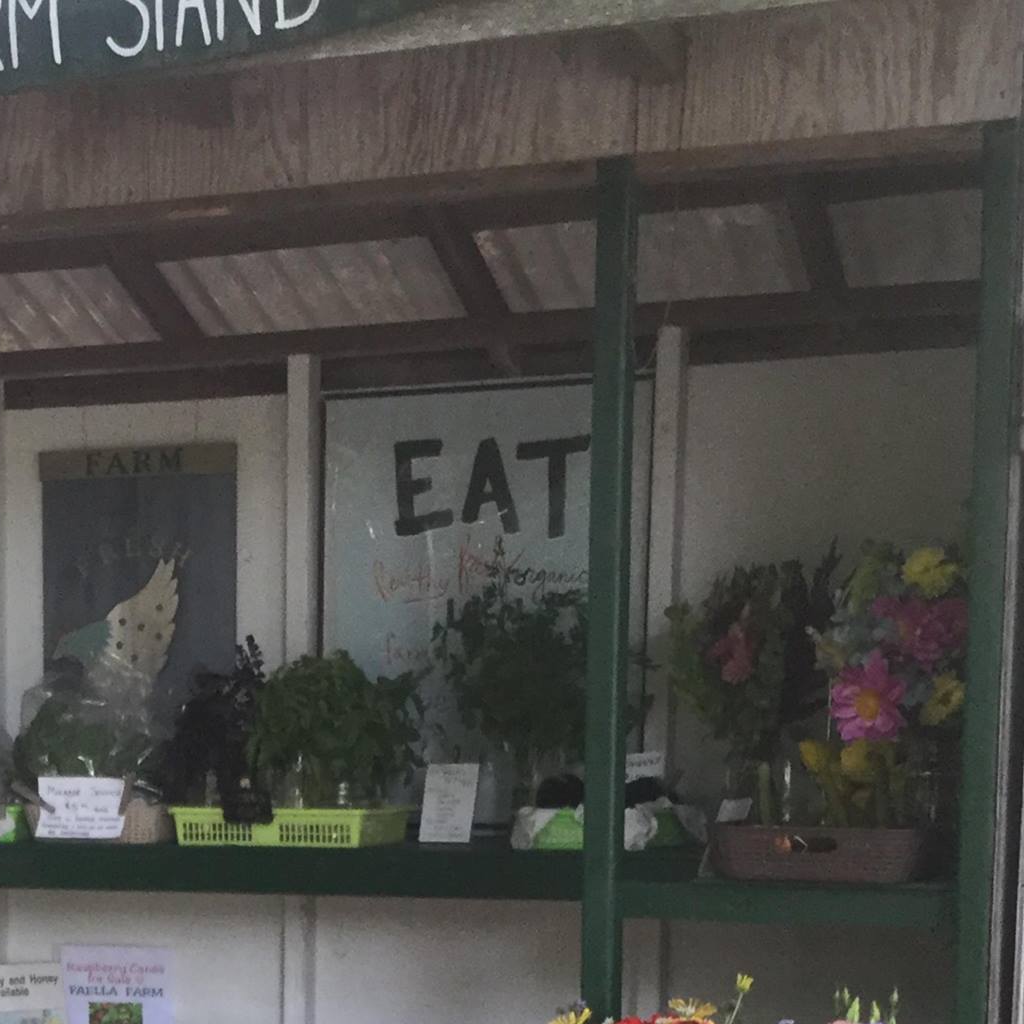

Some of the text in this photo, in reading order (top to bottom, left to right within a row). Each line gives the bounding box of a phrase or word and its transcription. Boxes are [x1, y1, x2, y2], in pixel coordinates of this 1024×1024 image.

[84, 448, 185, 477] FARM
[393, 433, 592, 540] EAT
[9, 976, 26, 986] and
[29, 973, 58, 985] Honey
[68, 984, 164, 998] FAELLA FARM
